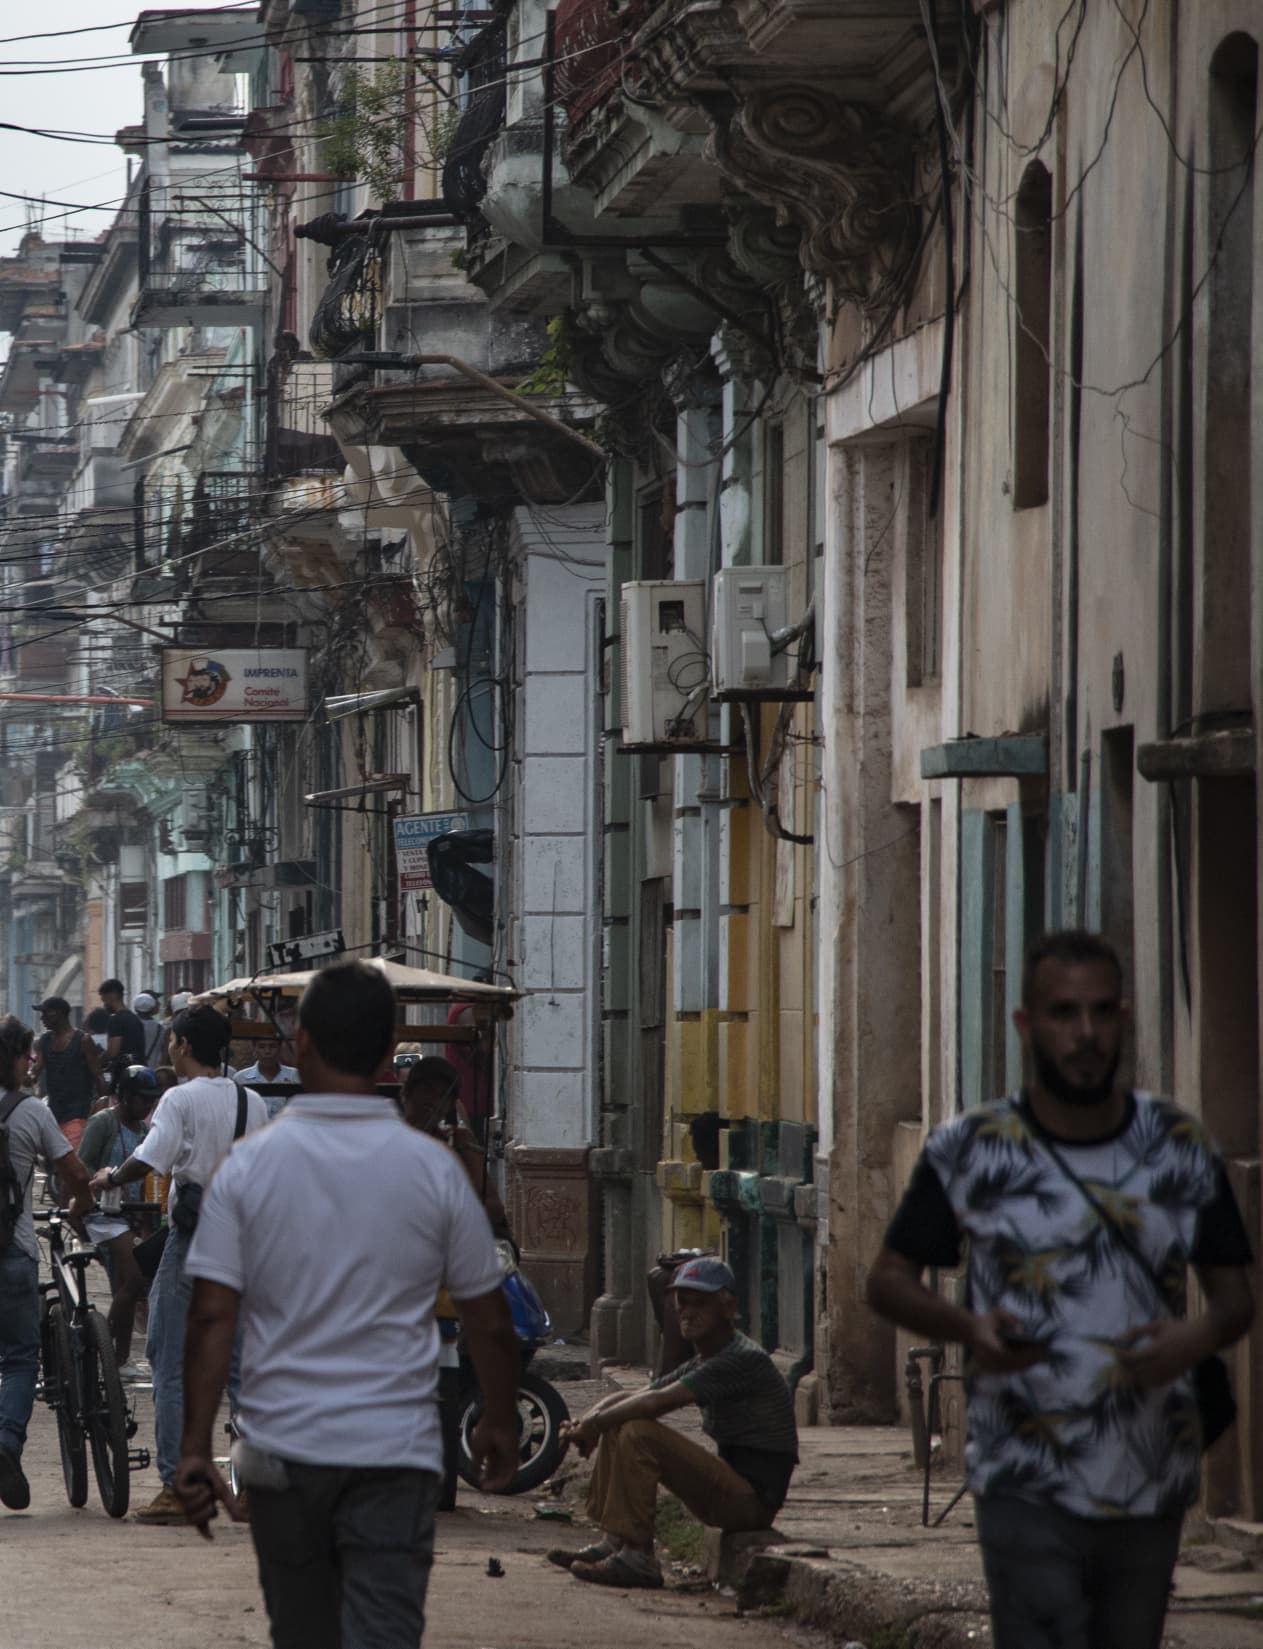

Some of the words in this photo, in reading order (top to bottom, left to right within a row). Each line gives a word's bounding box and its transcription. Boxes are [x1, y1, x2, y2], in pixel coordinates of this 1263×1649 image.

[244, 668, 297, 678] IMPRENTA
[244, 698, 289, 707] Nacional
[397, 820, 441, 834] AGENTE
